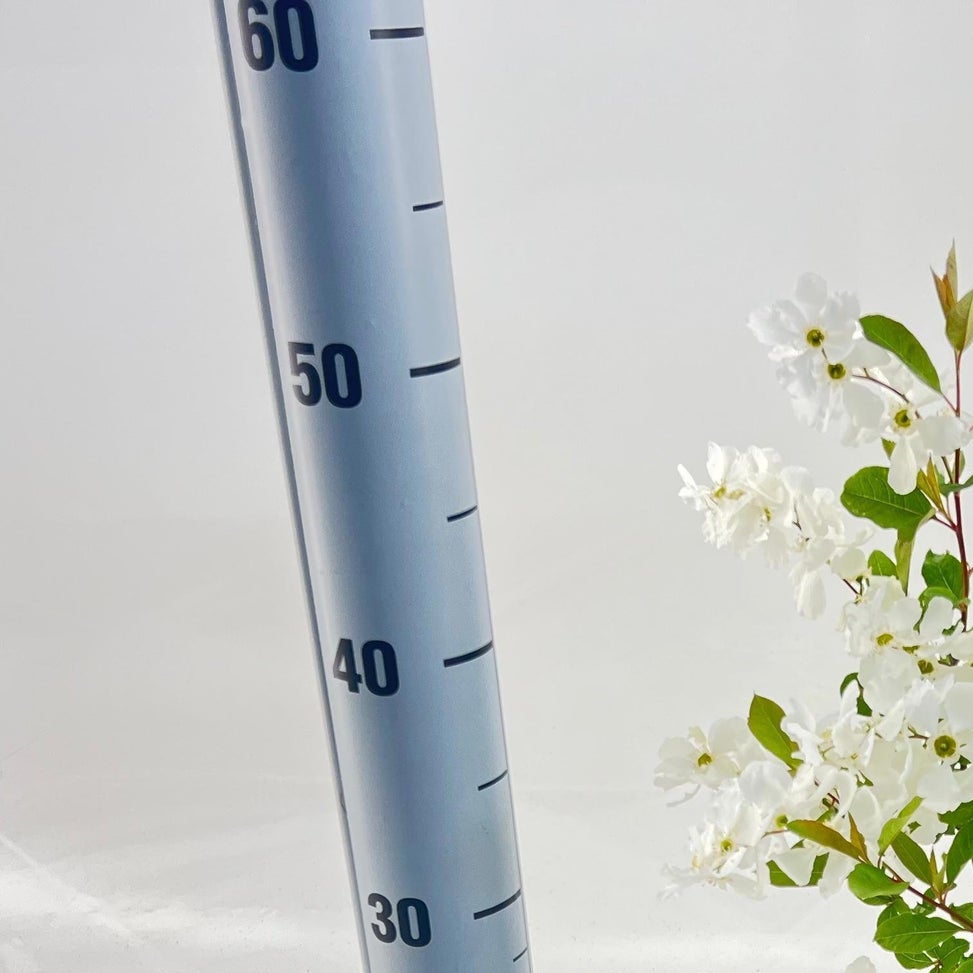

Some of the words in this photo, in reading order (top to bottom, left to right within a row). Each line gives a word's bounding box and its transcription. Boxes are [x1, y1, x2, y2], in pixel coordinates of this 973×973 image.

[239, 0, 319, 72] 60
[288, 341, 362, 409] 50
[333, 638, 400, 697] 40
[367, 893, 432, 947] 30
